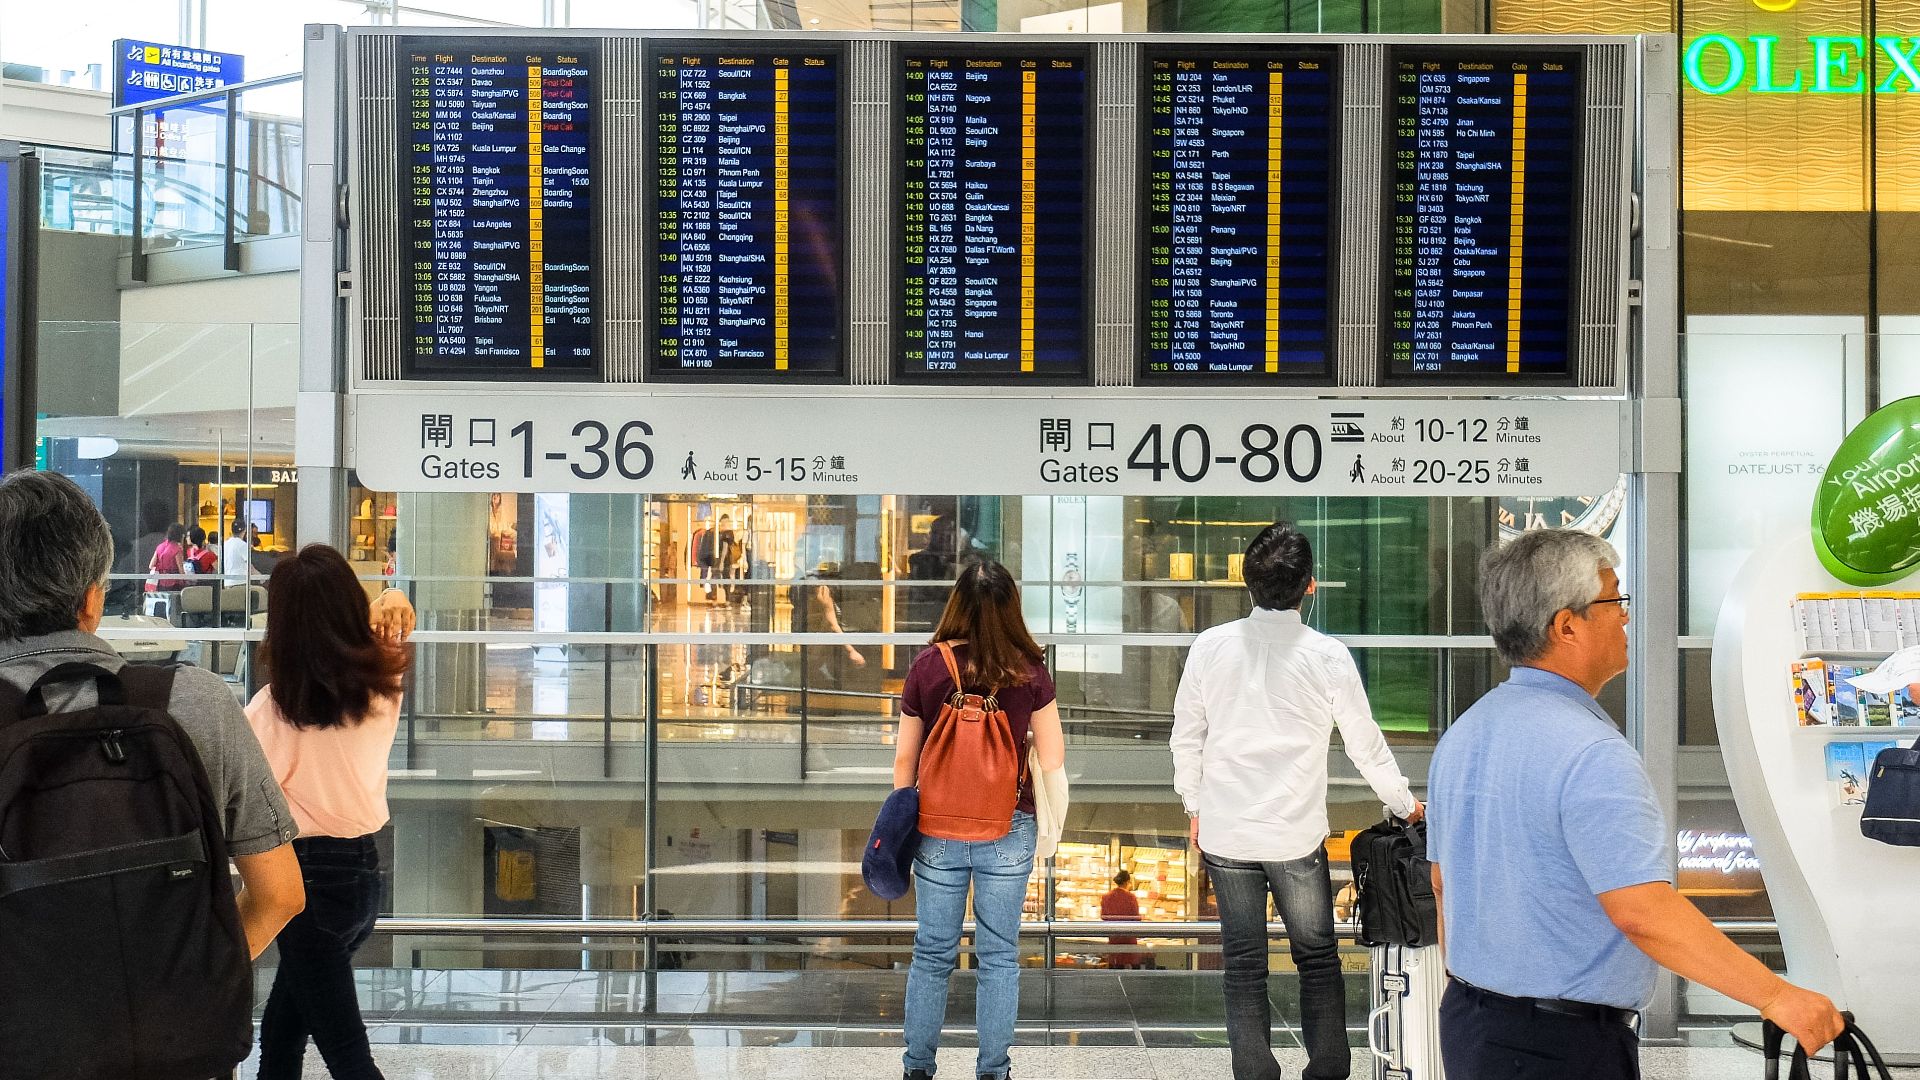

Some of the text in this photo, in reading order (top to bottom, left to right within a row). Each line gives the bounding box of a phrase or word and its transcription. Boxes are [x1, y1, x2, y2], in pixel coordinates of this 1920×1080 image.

[435, 54, 578, 63] Flight Destination Gate Status
[682, 57, 825, 66] Flight Destination Gate Status
[930, 59, 1072, 68] Flight Destination Gate Status
[172, 60, 202, 72] boarding
[202, 65, 221, 73] gates
[1177, 61, 1319, 70] Flight Destination Gate Status
[1423, 62, 1563, 71] Flight Destination Gate Status
[543, 68, 587, 77] BoardingSoon
[543, 101, 588, 110] BoardingSoon
[543, 112, 571, 121] Boarding
[561, 145, 585, 154] Change
[545, 285, 589, 293] BoardingSoon
[1391, 416, 1404, 430] 約
[1497, 416, 1529, 430] 分鐘
[422, 414, 495, 448] 閘口
[1040, 419, 1114, 453] 閘口
[1371, 419, 1540, 442] About 10-12 Minutes
[422, 421, 653, 480] Gates 1-36
[1040, 424, 1322, 483] Gates 40-80
[725, 455, 738, 469] 約
[813, 456, 845, 469] 分鐘
[1392, 457, 1405, 471] 約
[1497, 458, 1529, 472] 分鐘
[704, 458, 857, 482] About 5-15 Minutes
[1371, 460, 1542, 483] About 20-25 Minutes
[1728, 464, 1825, 474] DATEJUST 36
[271, 470, 298, 483] BAL
